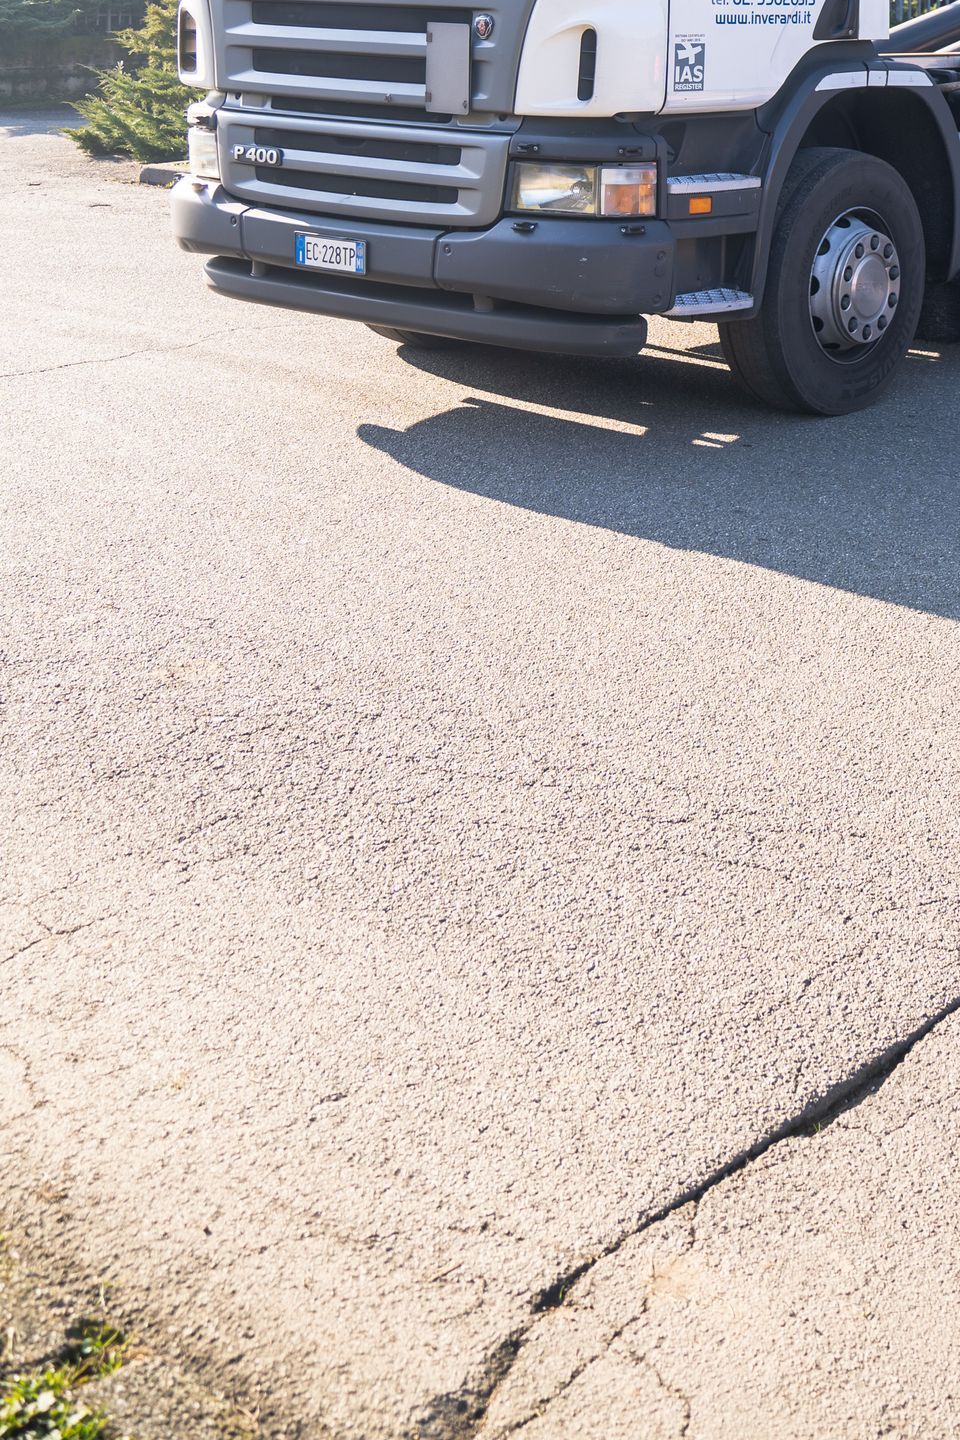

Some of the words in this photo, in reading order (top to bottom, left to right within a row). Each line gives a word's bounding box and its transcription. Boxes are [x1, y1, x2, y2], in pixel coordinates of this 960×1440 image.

[715, 11, 812, 25] www.inverardi.it
[674, 65, 704, 83] IAS
[674, 83, 704, 91] REGISTER
[233, 145, 245, 160] P
[245, 147, 278, 165] 400
